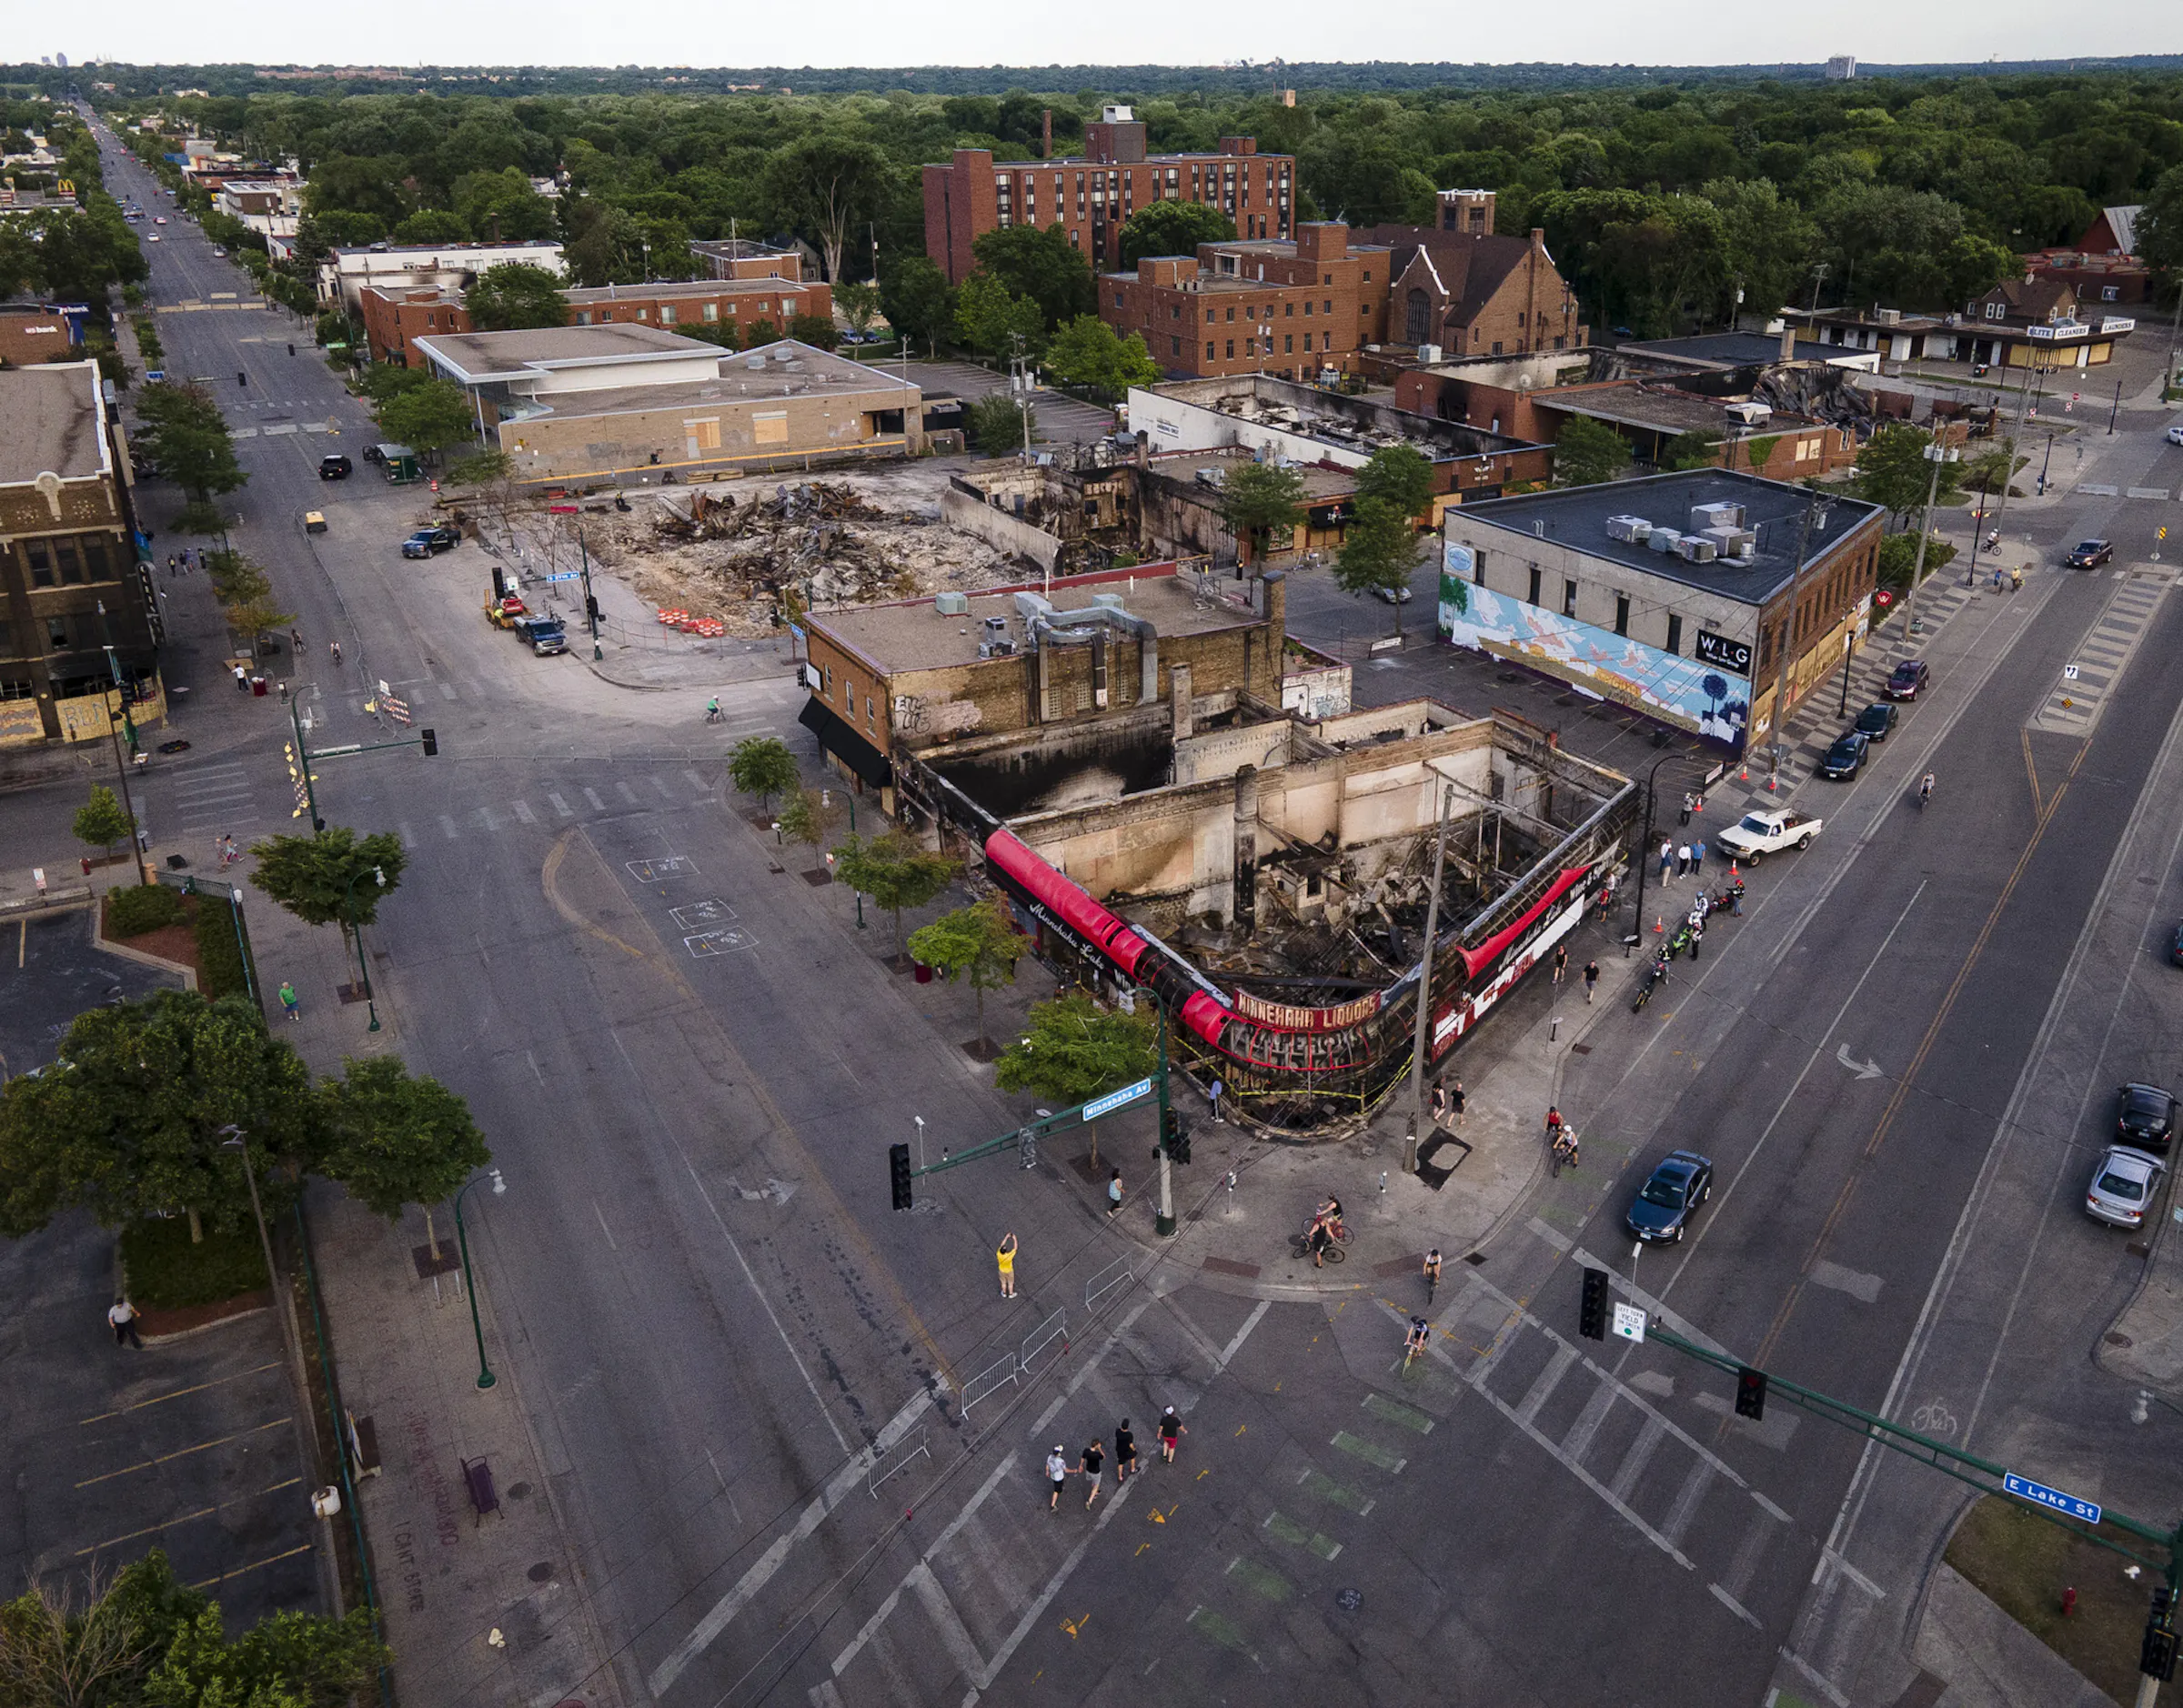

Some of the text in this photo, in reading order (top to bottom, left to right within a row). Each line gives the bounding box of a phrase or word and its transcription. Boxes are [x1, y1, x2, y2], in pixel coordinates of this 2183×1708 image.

[2057, 327, 2087, 337] CLEANERS
[1238, 993, 1375, 1029] MINNEHAHA LIQUORS
[1086, 1084, 1147, 1117] Minnehaha Av
[2009, 1479, 2094, 1518] E Lake St
